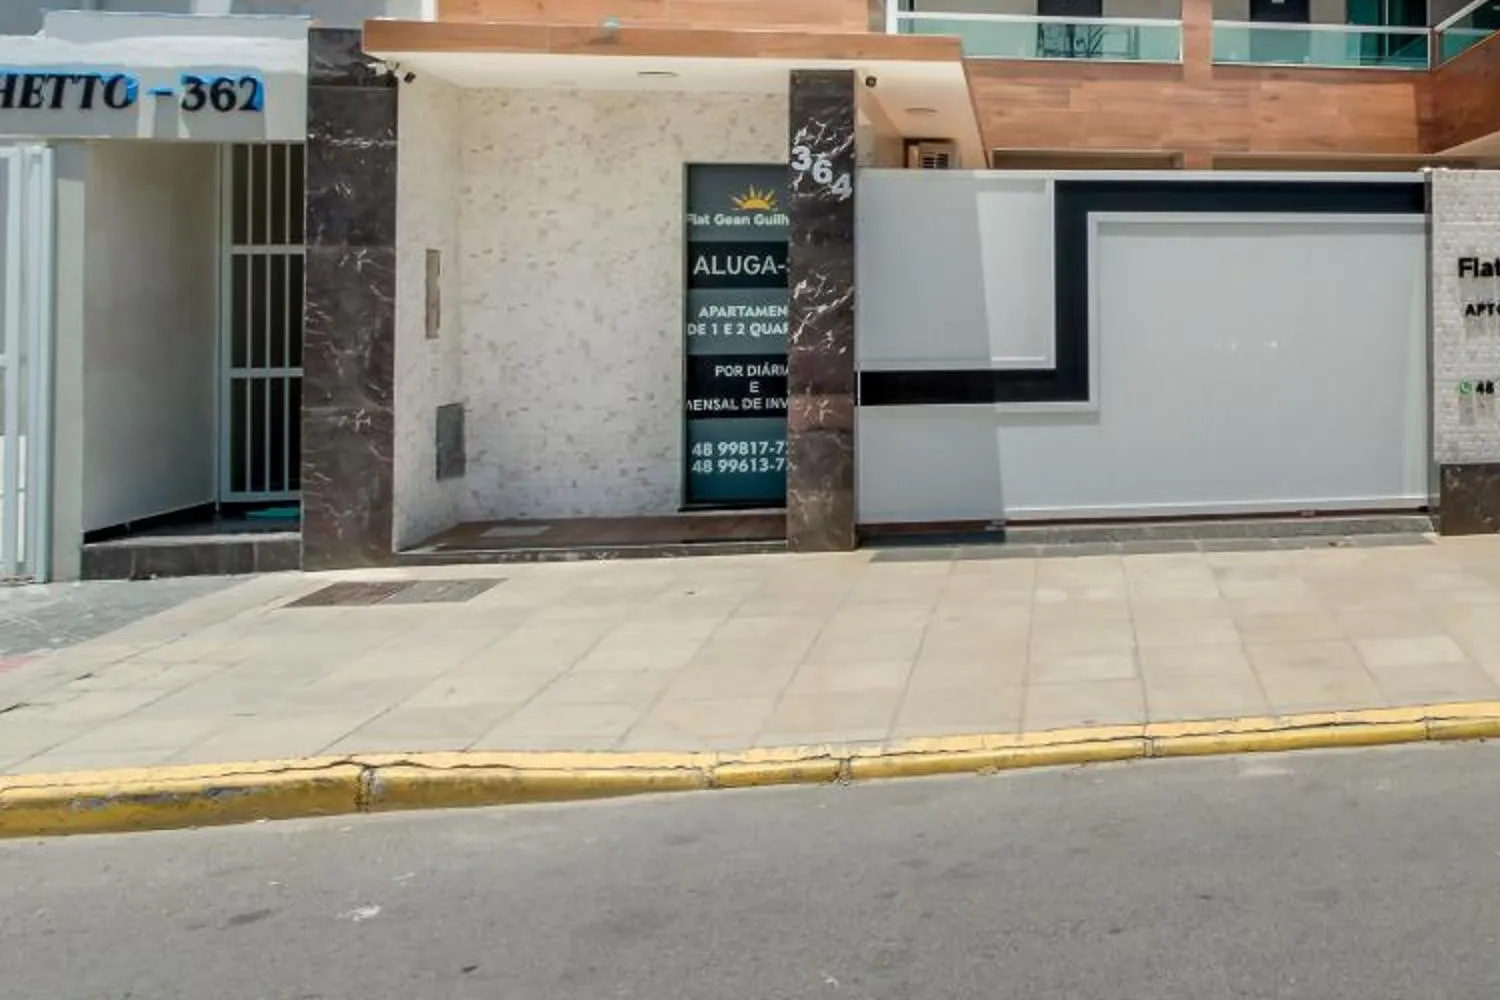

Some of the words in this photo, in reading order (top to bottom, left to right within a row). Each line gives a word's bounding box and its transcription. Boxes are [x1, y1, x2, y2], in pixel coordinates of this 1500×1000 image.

[180, 74, 261, 112] 362
[791, 145, 853, 200] 364
[714, 213, 751, 226] Gean
[693, 255, 789, 276] ALUGA-
[687, 323, 707, 336] DE
[711, 323, 718, 336] 1
[723, 323, 733, 335] E
[735, 323, 746, 335] 2
[715, 365, 744, 378] POR
[749, 381, 760, 393] E
[1475, 380, 1495, 394] 48
[741, 398, 763, 411] DE
[691, 441, 713, 457] 48
[717, 440, 788, 456] 99817-7
[691, 458, 713, 474] 48
[717, 457, 788, 473] 99613-7
